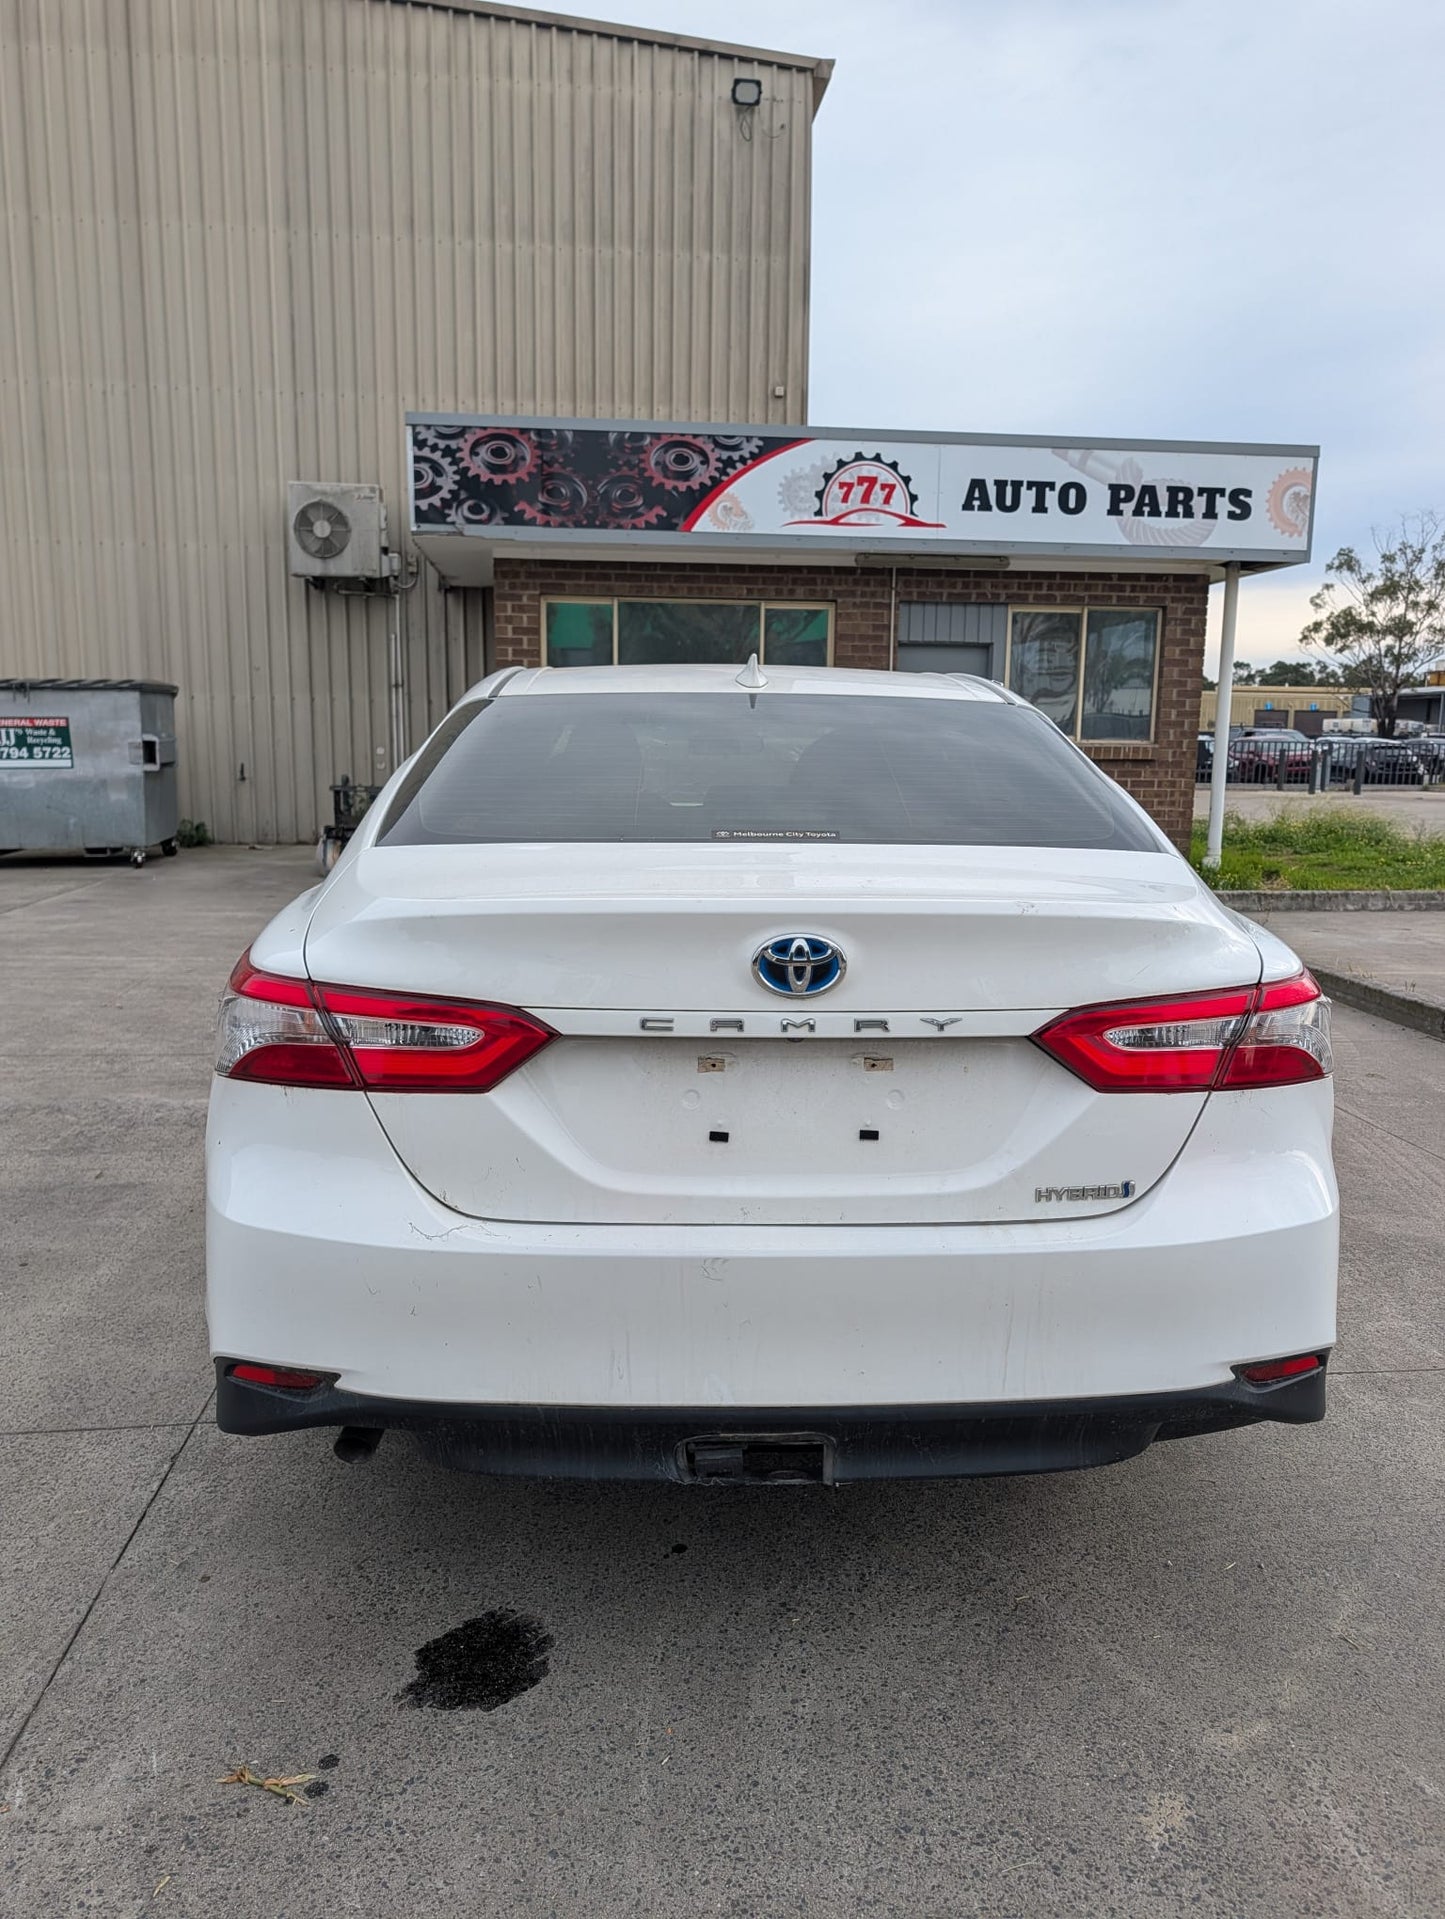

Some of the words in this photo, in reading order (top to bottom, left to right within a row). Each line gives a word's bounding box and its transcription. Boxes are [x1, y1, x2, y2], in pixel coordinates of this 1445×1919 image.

[838, 475, 897, 506] 777
[961, 478, 1088, 516] AUTO
[1106, 483, 1253, 522] PARTS
[33, 718, 67, 727] WASTE
[27, 736, 62, 746] Recycling
[33, 746, 71, 759] 5722
[785, 831, 804, 839] City
[805, 831, 837, 839] Toyota
[640, 1017, 963, 1033] CAMRY
[1035, 1184, 1121, 1203] HYBRID
